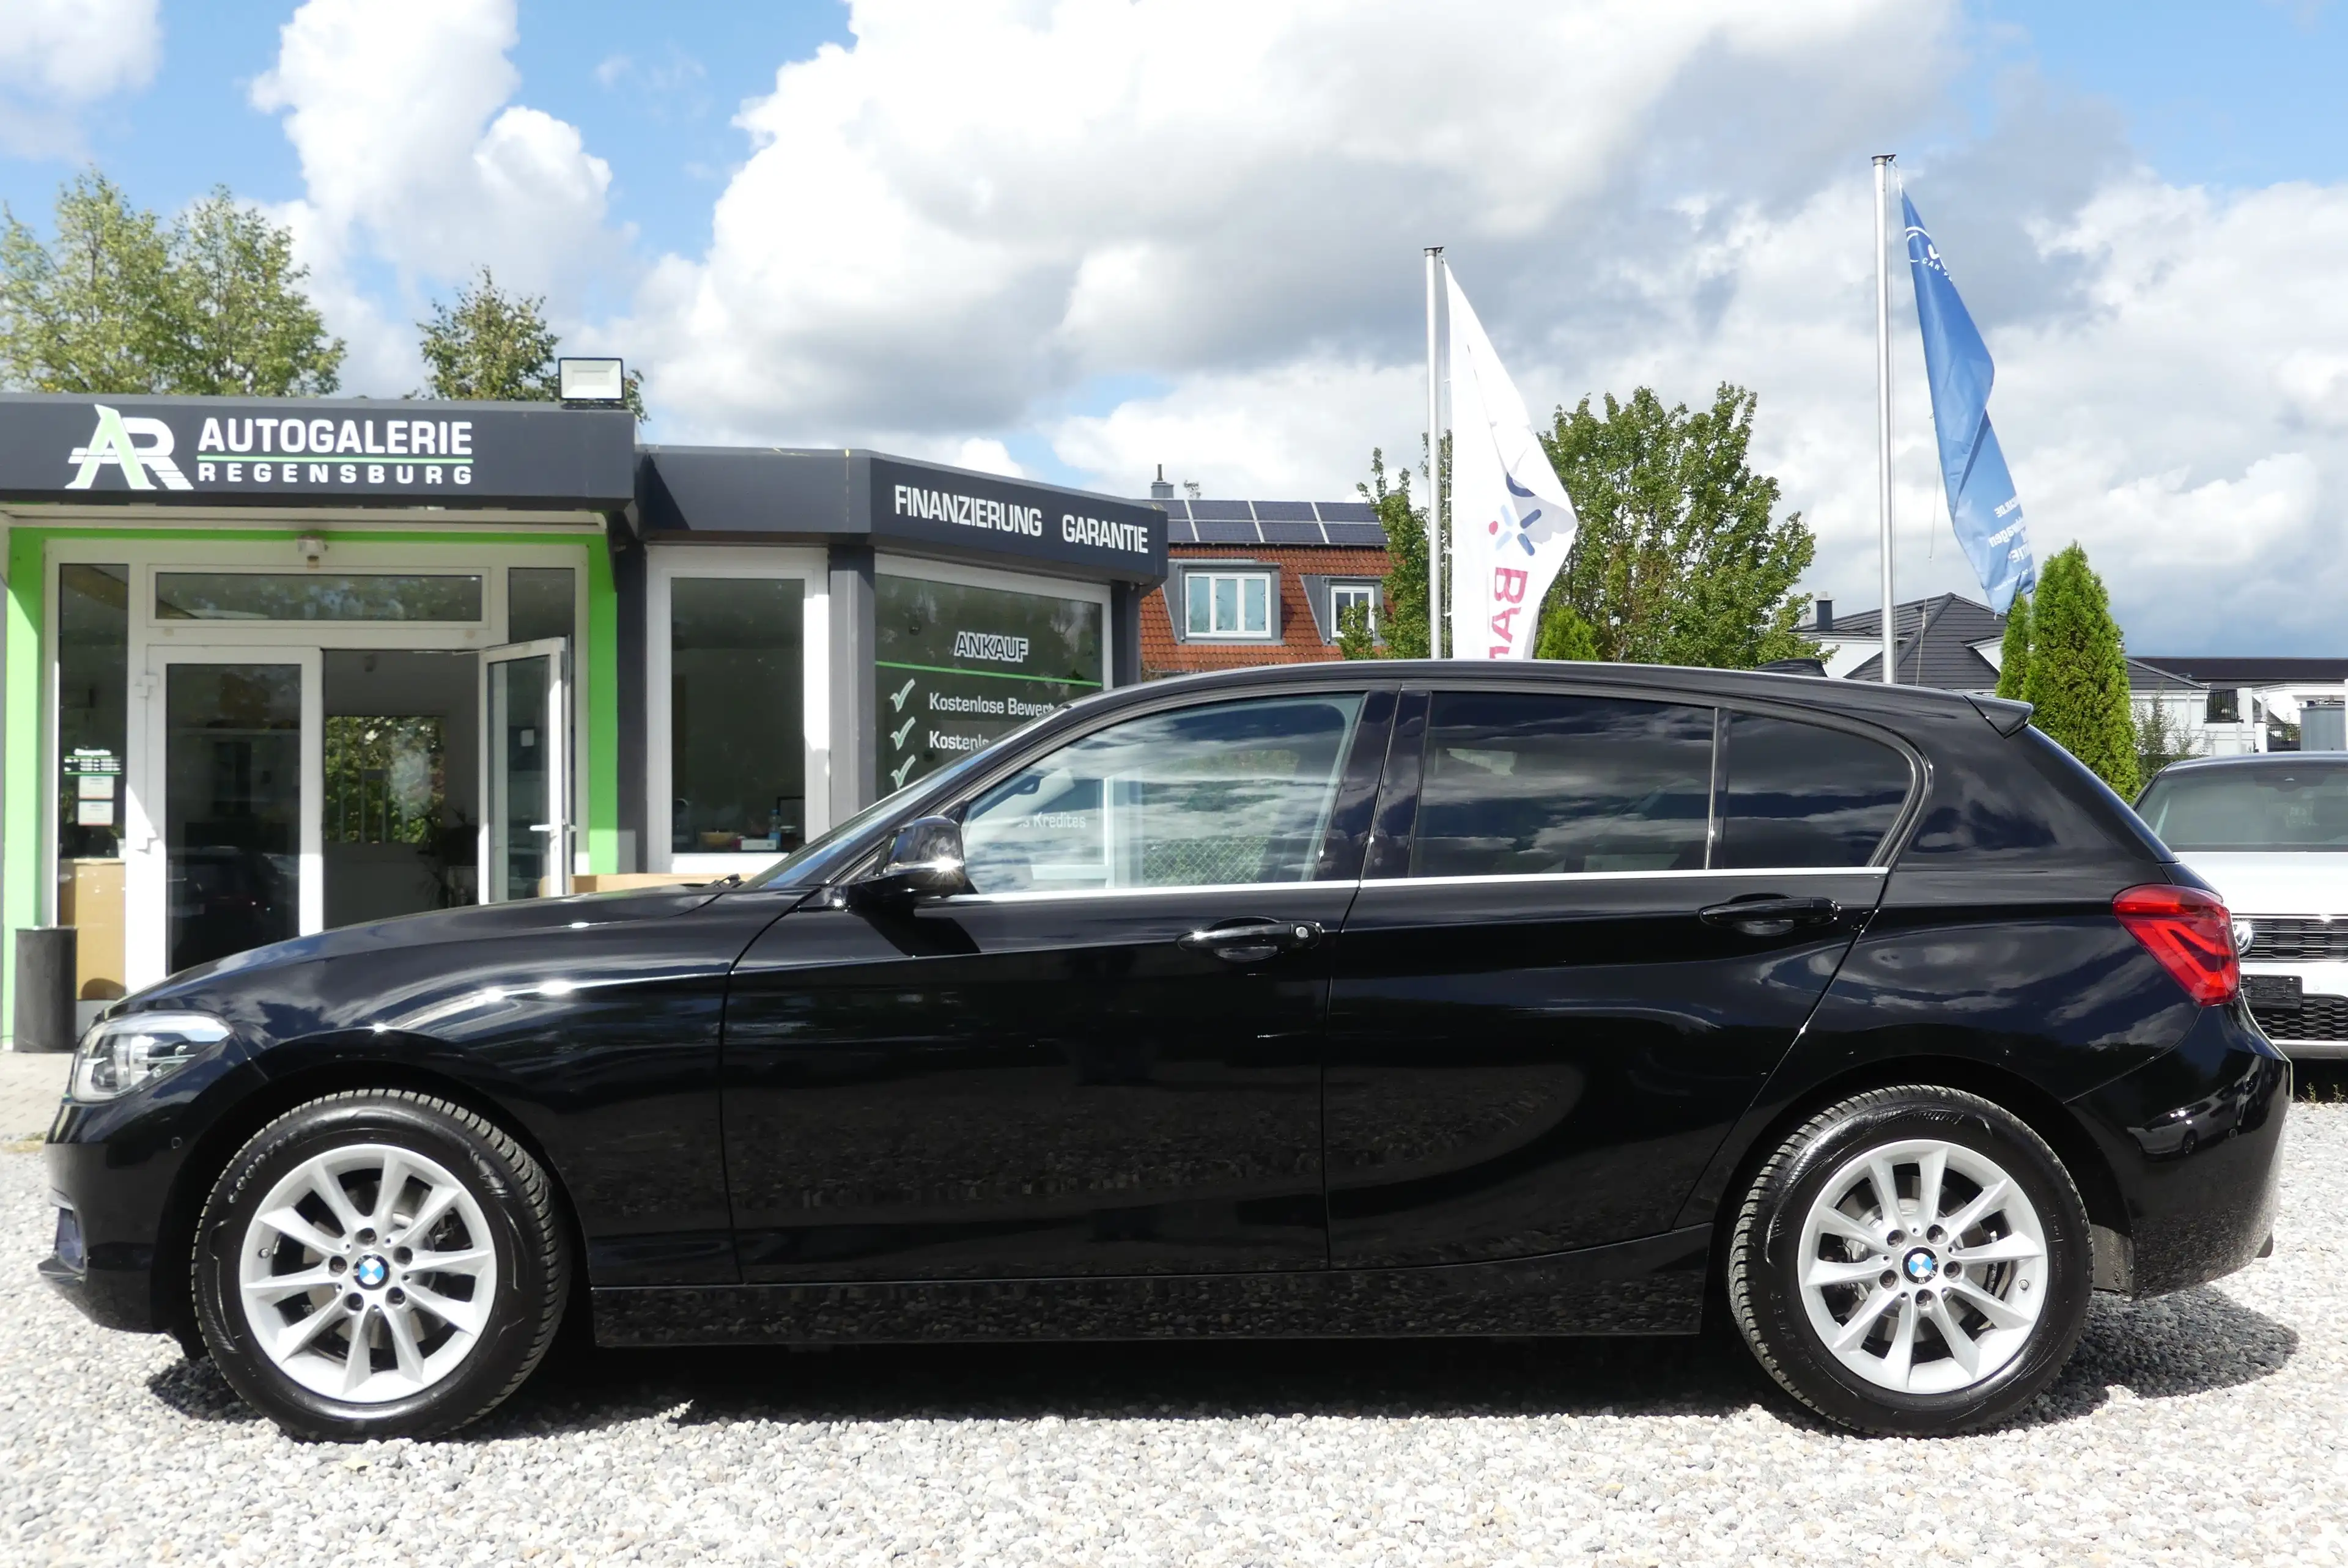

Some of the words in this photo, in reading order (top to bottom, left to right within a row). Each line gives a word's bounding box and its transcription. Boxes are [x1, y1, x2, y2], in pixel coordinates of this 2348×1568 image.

[198, 417, 473, 455] AUTOGALERIE
[198, 462, 473, 485] REGENSBURG
[895, 485, 1043, 537] FINANZIERUNG
[1062, 514, 1148, 554] GARANTIE
[953, 631, 1029, 663] ANKAUF
[929, 692, 1005, 714] Kostenlose
[1033, 812, 1086, 828] Kredites
